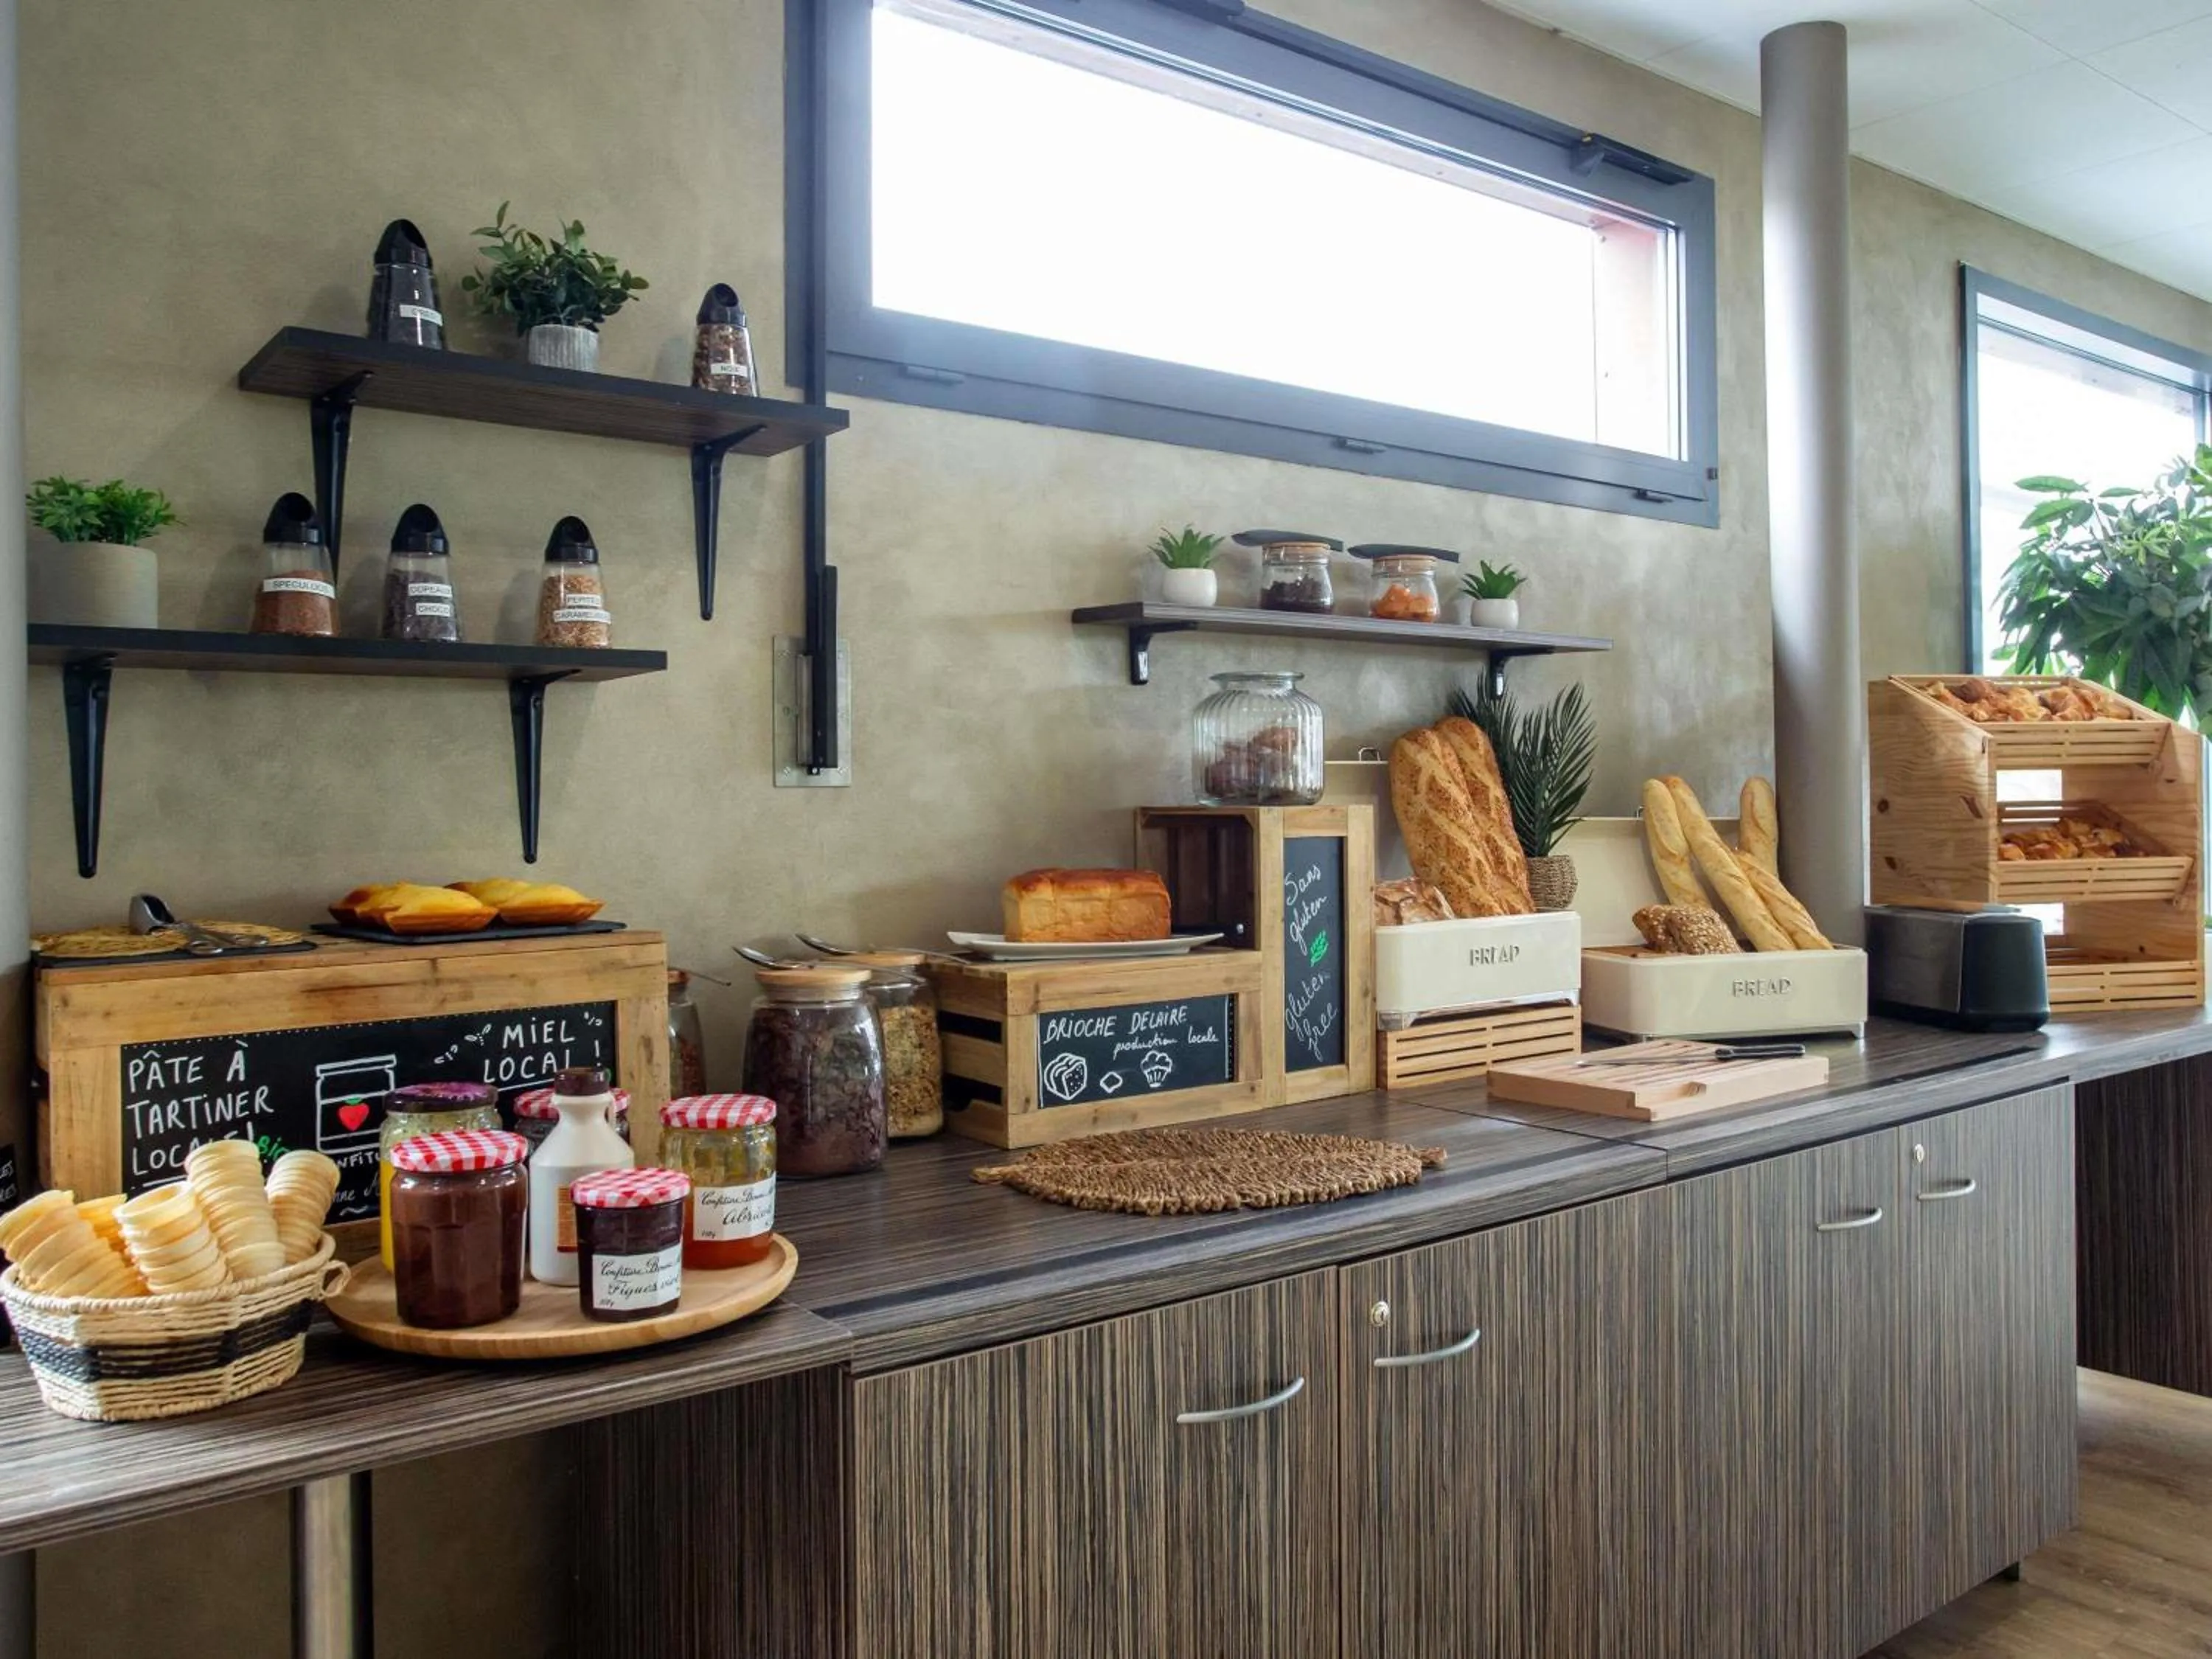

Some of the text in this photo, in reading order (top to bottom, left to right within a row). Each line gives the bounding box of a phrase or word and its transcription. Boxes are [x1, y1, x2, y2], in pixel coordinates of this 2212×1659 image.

[1284, 863, 1321, 906] Sans
[1290, 896, 1327, 956] gluten
[1470, 945, 1520, 966] BREAD
[1285, 972, 1330, 1042] gluten
[1732, 978, 1792, 998] BREAD
[1111, 1026, 1220, 1061] production locale
[1303, 1002, 1338, 1062] free
[128, 1039, 249, 1093] PÂTE À
[608, 1279, 658, 1299] Figues
